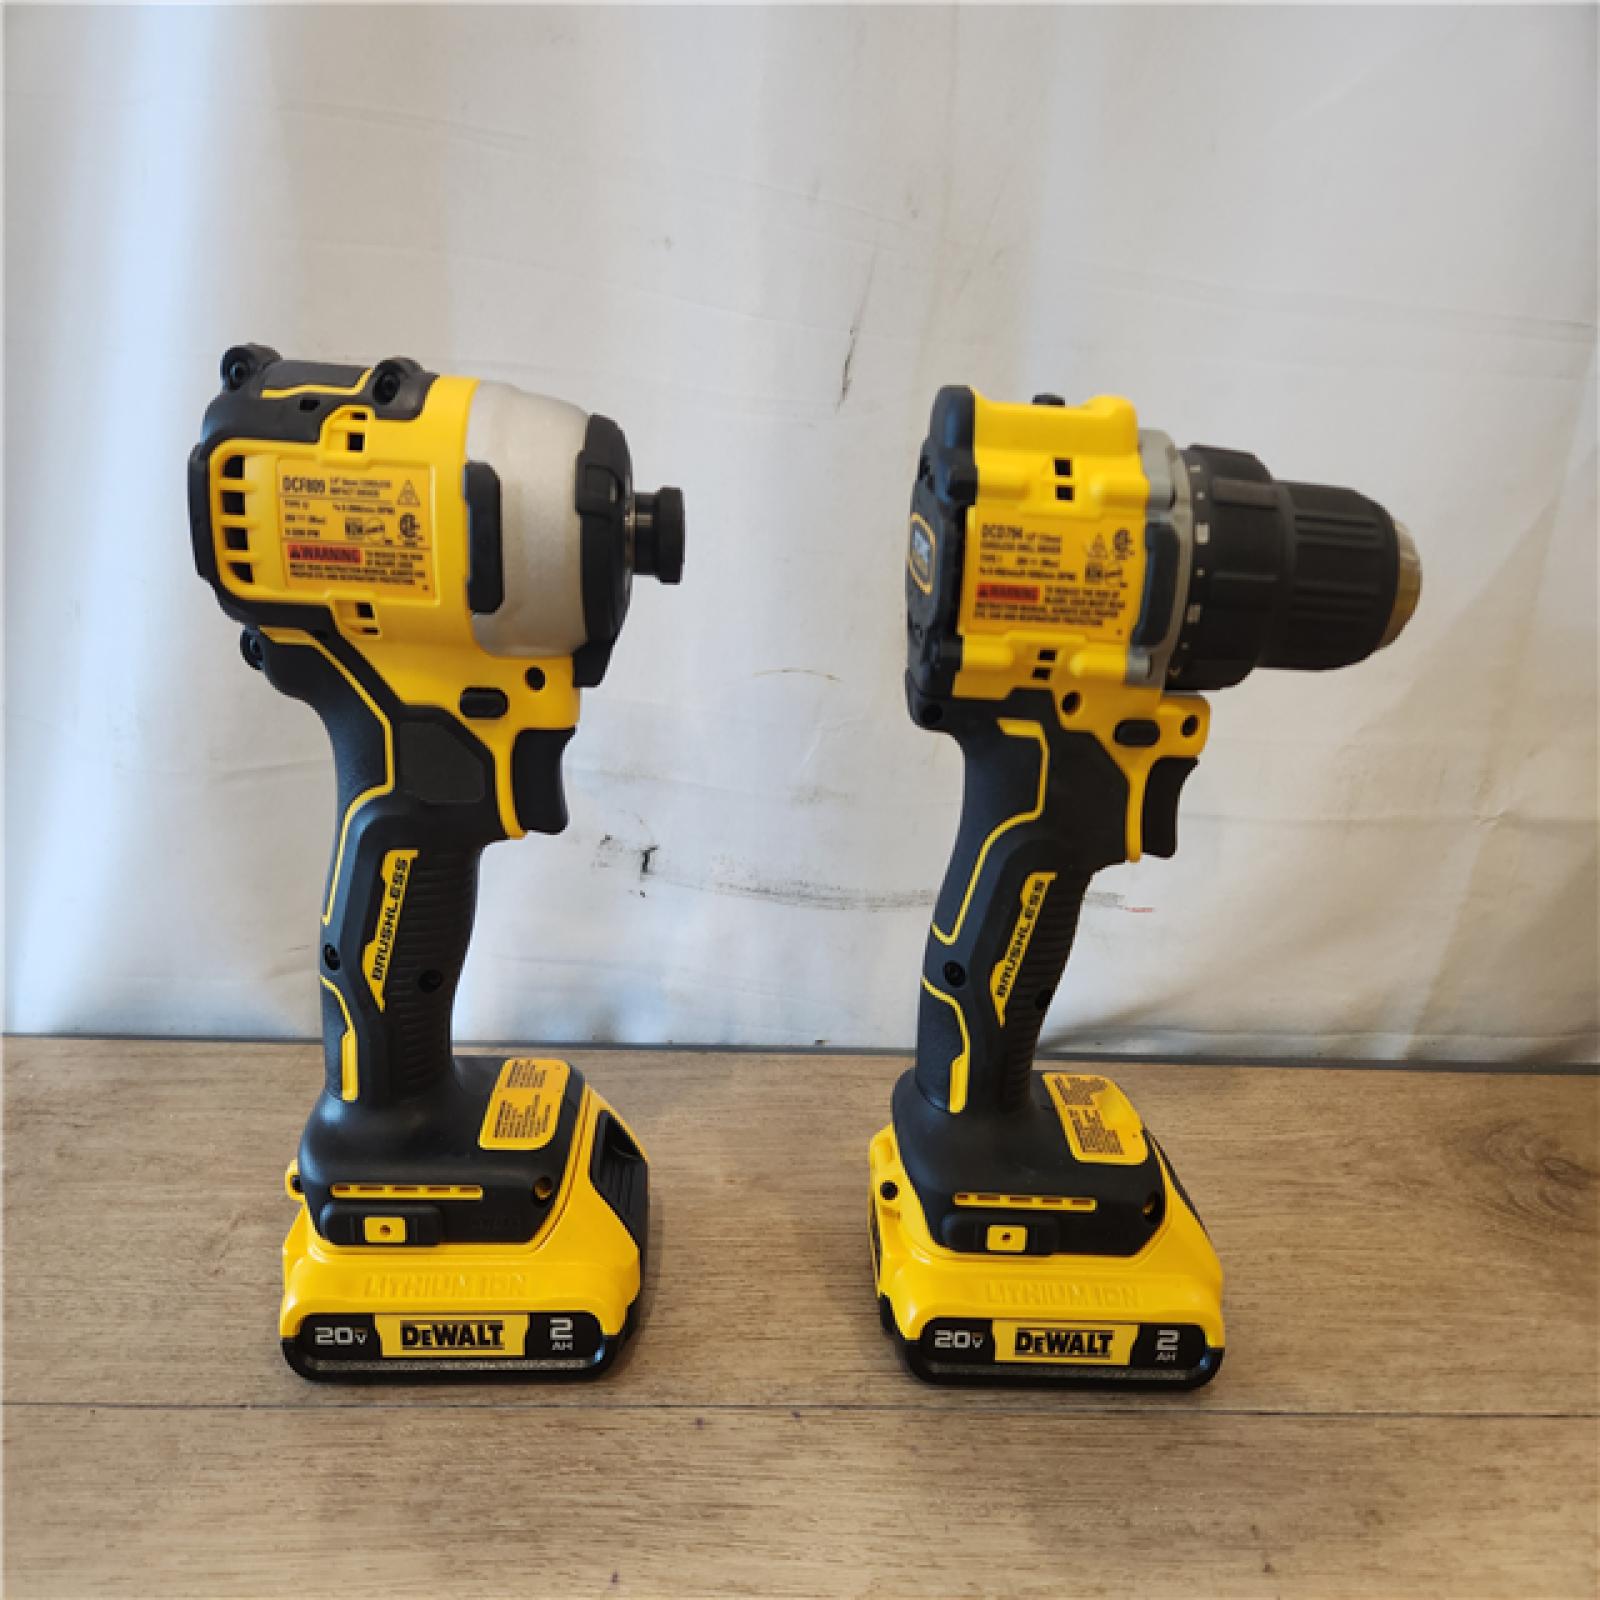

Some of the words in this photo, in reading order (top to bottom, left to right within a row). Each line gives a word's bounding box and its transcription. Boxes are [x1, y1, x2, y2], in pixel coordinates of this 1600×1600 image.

[371, 857, 408, 981] BRUSHLESS
[994, 880, 1044, 996] BRUSHLESS
[550, 1317, 573, 1340] 2
[1156, 1329, 1180, 1350] 2
